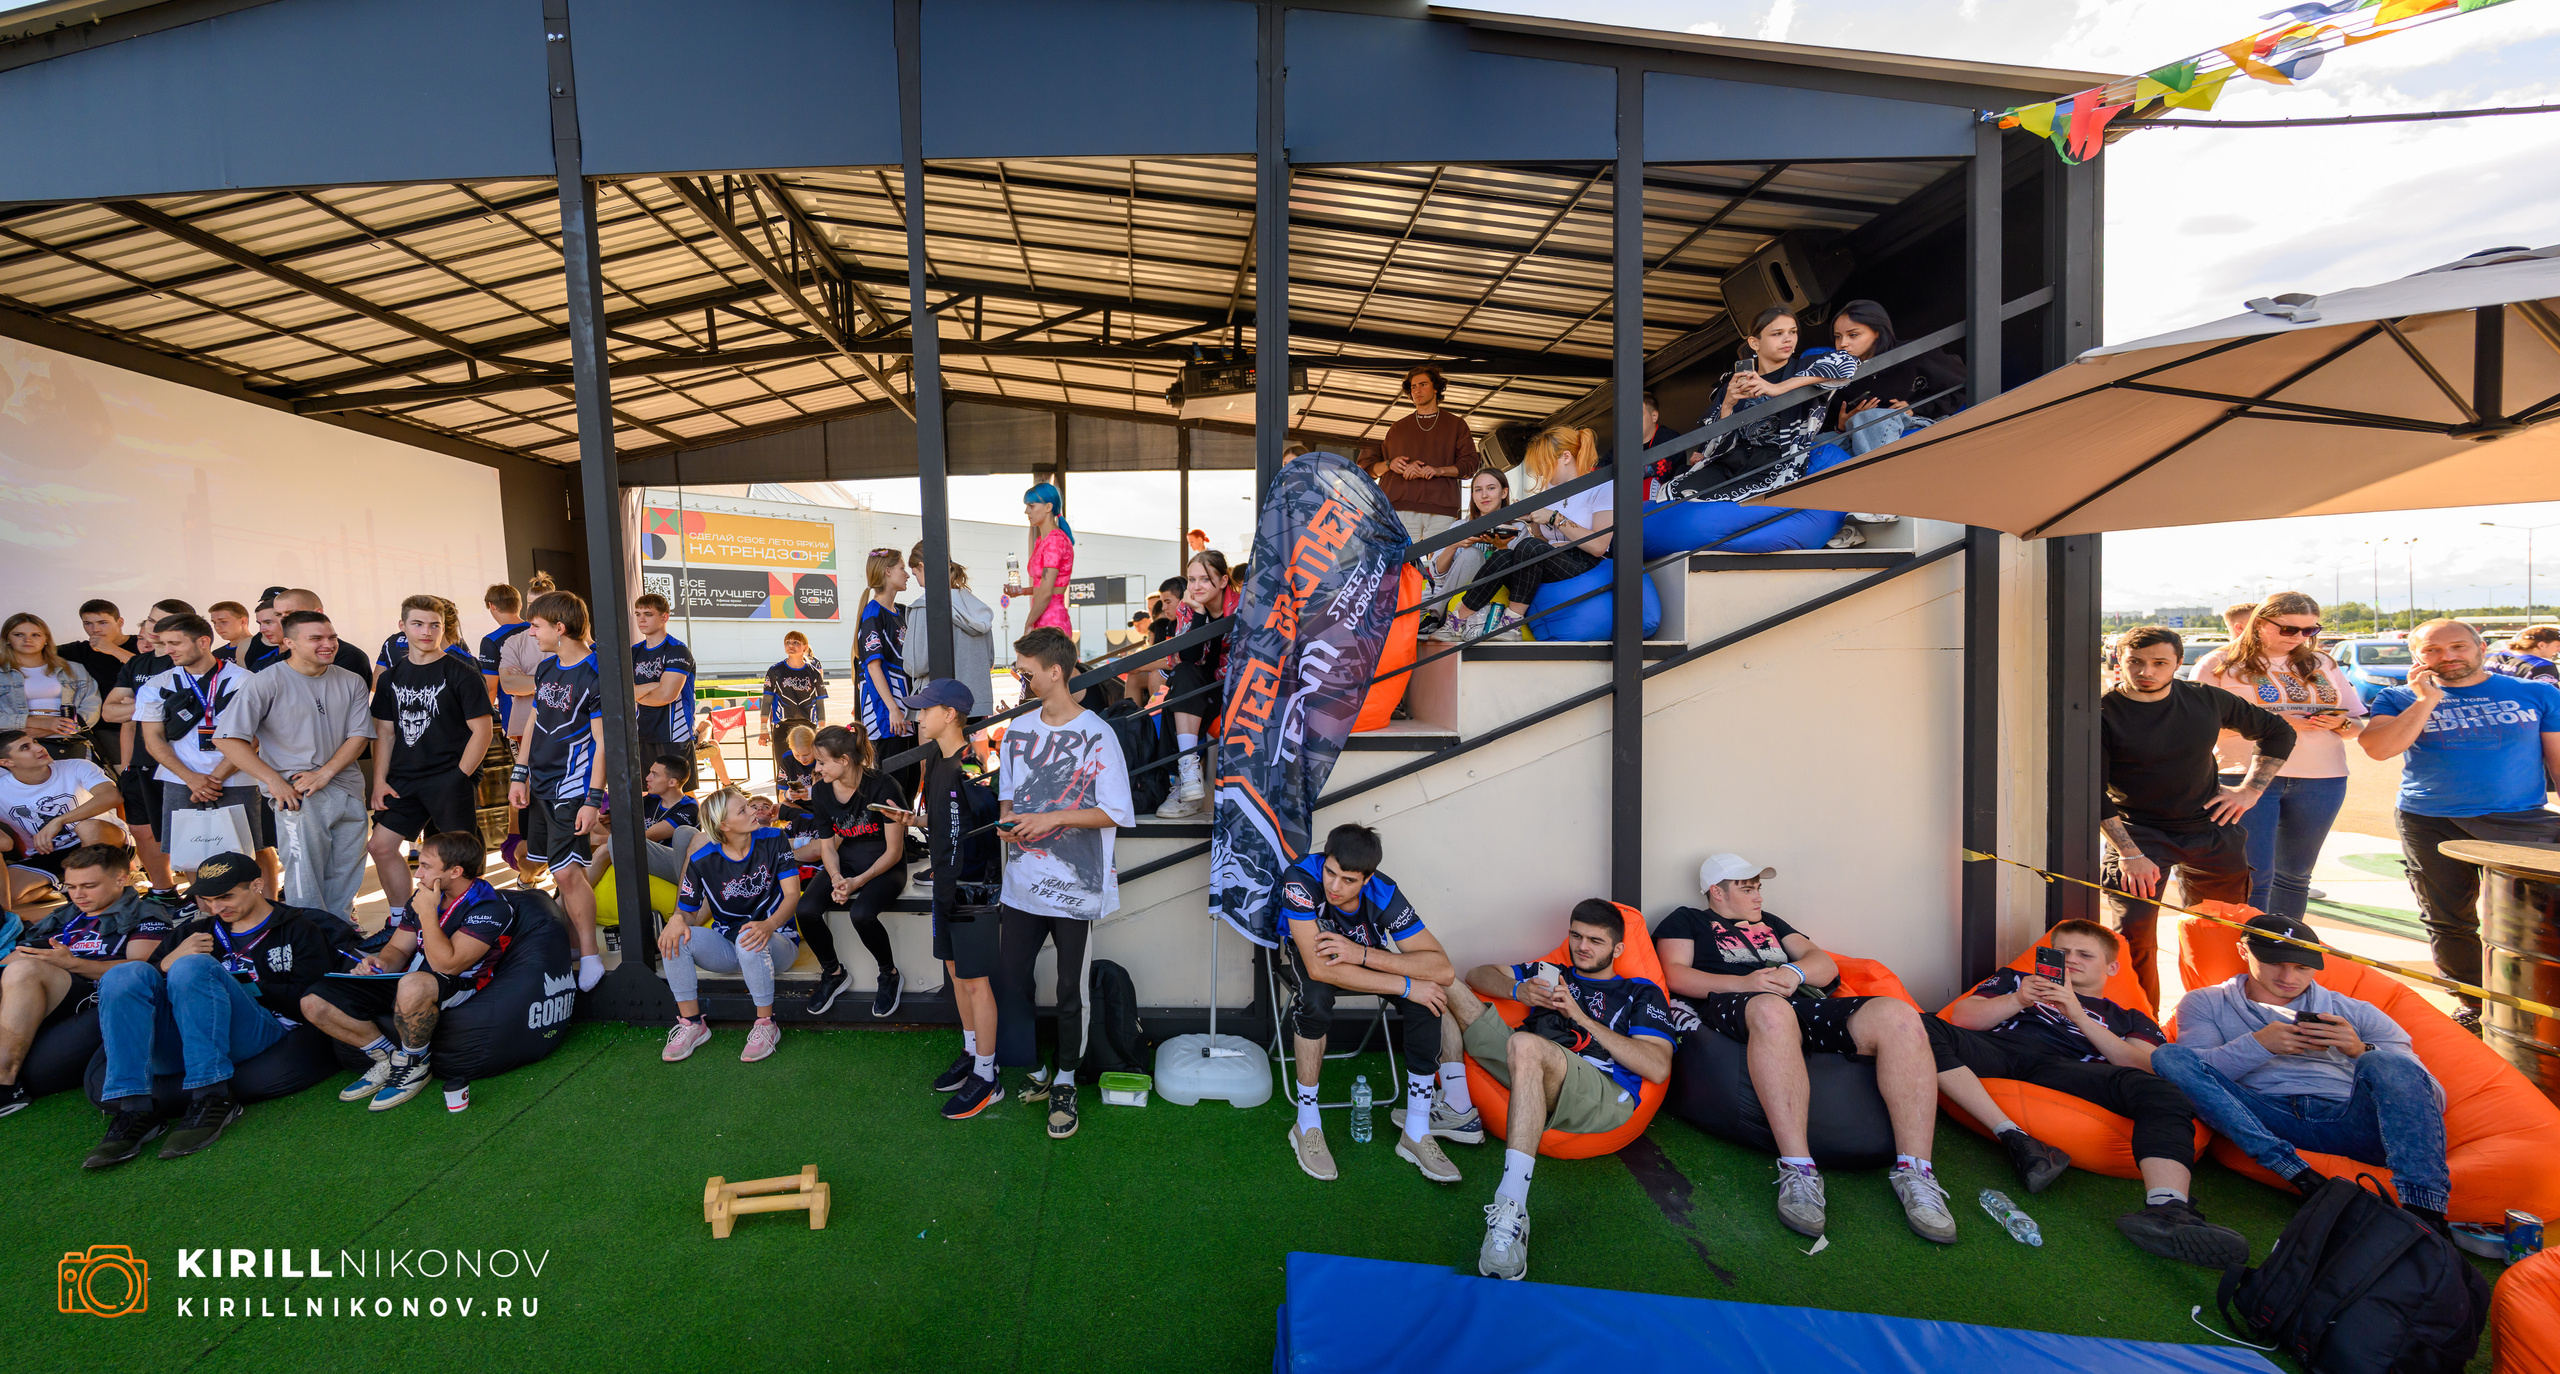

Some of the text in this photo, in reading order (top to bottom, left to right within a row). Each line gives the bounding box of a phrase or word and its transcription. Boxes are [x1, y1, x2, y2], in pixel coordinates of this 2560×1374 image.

[689, 532, 829, 549] СДЕЛАЙ СВОЕ ЛЕТО ЯРКИМ
[690, 543, 830, 562] НА ТРЕНДЗОНЕ
[679, 579, 706, 588] ВСЕ
[799, 589, 834, 597] ТРЕНД
[1070, 582, 1096, 591] ТРЕНД
[1326, 560, 1367, 621] STREET
[1343, 553, 1387, 630] WORKOUT
[710, 589, 766, 599] ЛУЧШЕГО
[1070, 591, 1096, 600] ЗОНА
[1223, 654, 1287, 758] STEEL
[2428, 700, 2520, 721] MITED
[2423, 708, 2538, 733] EDITION
[1004, 729, 1103, 773] FURY
[1039, 877, 1076, 892] MEANT
[1029, 883, 1086, 907] TO BE FREE
